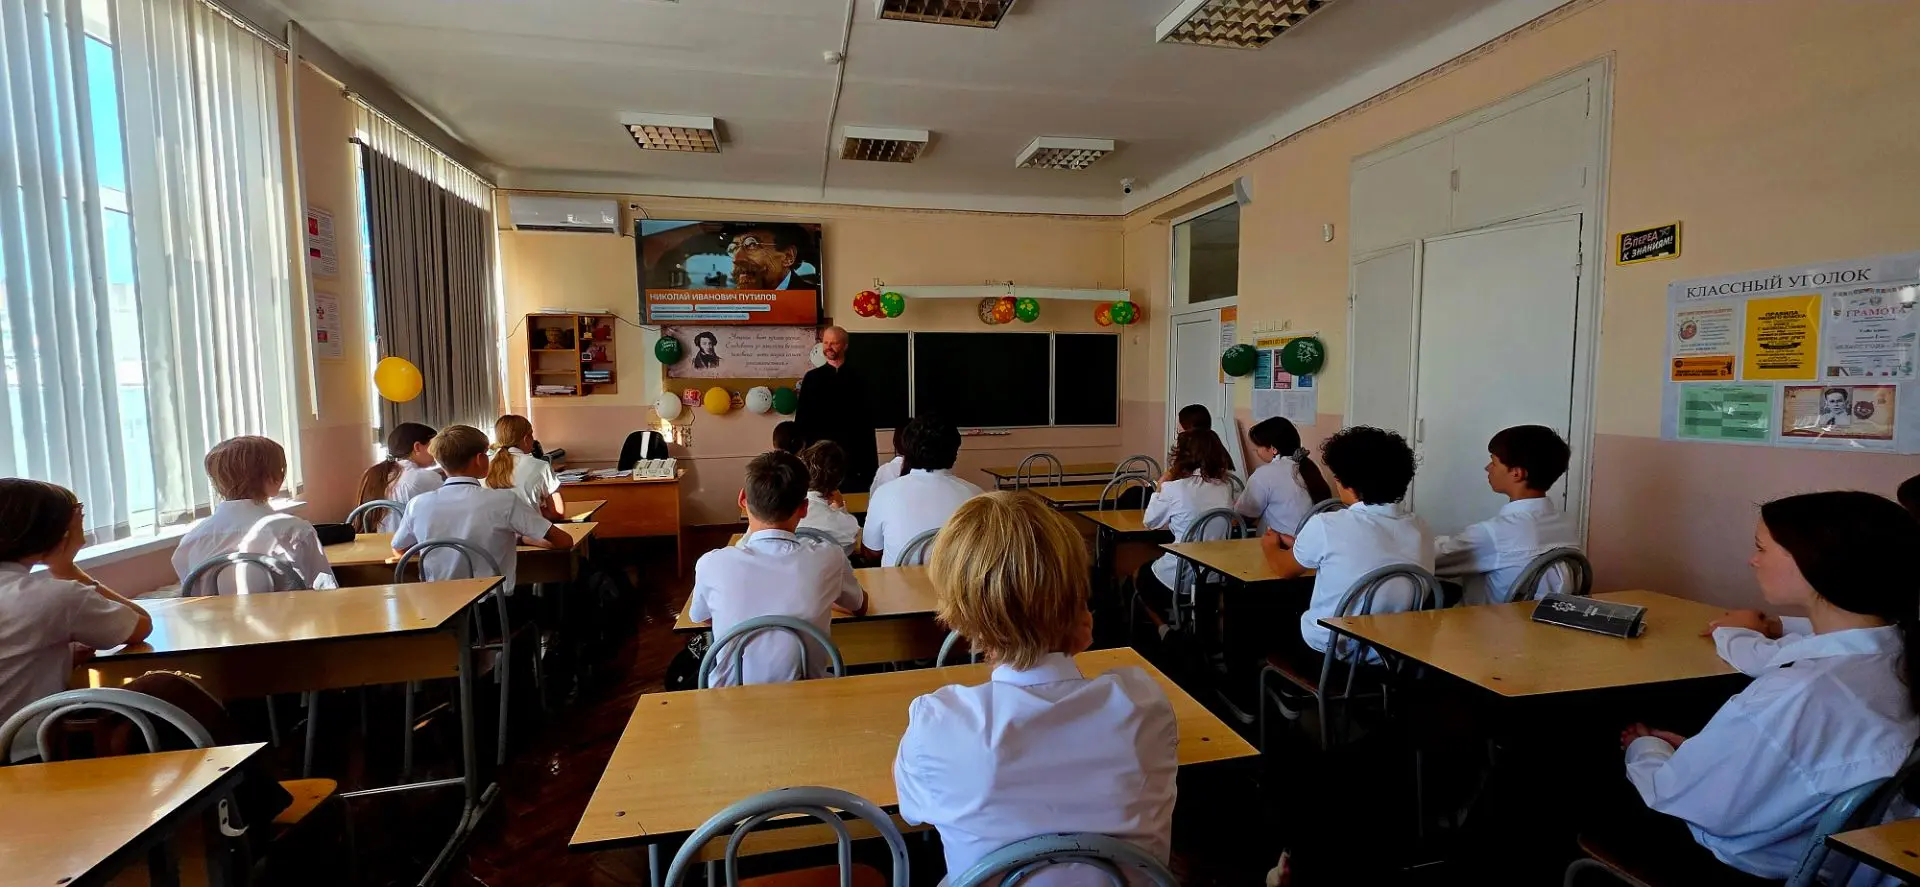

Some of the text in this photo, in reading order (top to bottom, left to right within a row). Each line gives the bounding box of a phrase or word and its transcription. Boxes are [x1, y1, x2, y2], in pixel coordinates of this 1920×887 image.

[1622, 230, 1659, 252] ВПЕРЕД
[1622, 235, 1674, 261] К ЗНАНИЯМ!
[1686, 268, 1872, 299] КЛАССНЫЙ УГОЛОК
[649, 292, 777, 301] НИКОЛАЙ ИВАНОВИЧ ПУТИЛОВ
[1845, 305, 1907, 318] ГРАМОТА
